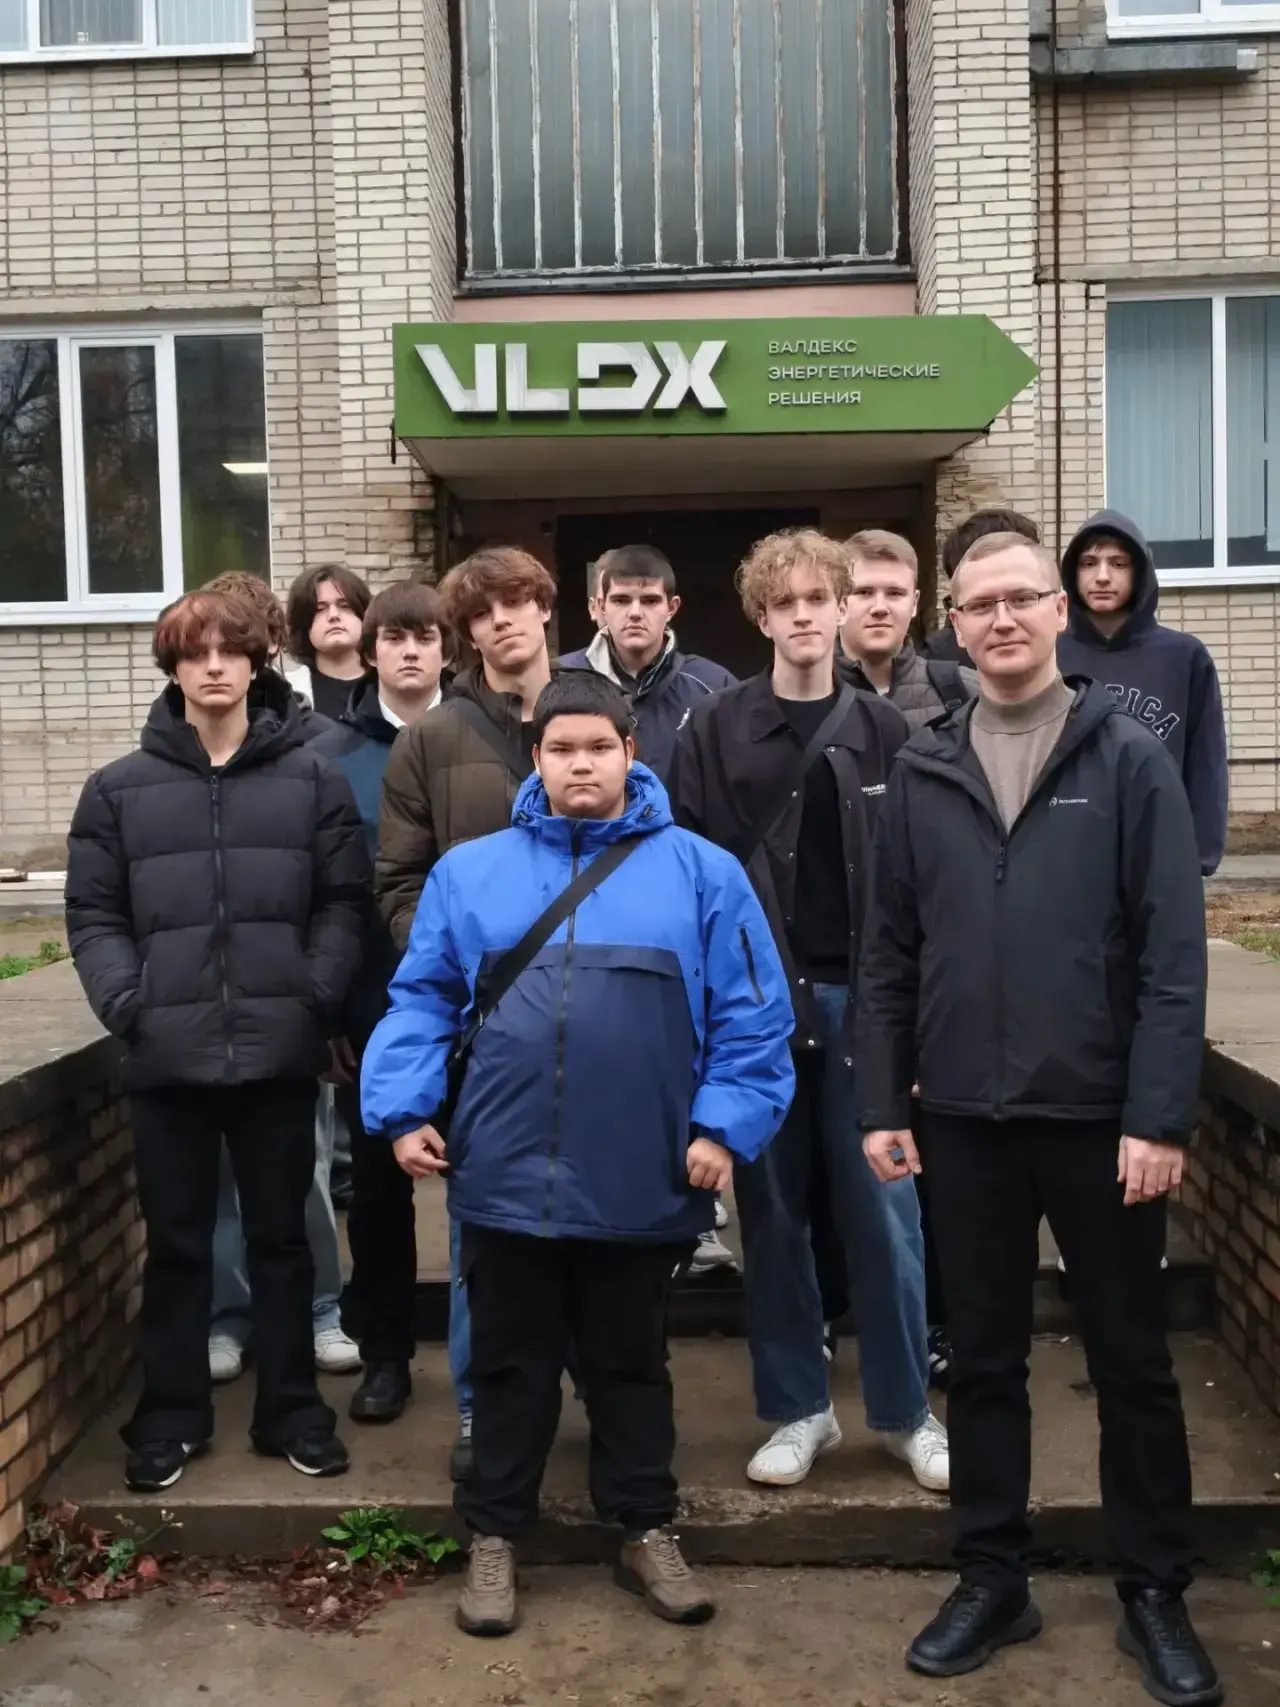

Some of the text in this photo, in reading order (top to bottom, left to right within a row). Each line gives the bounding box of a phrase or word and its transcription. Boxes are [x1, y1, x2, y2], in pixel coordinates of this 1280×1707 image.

[768, 340, 858, 355] ВАЛДЕКС
[414, 340, 728, 412] VLDX
[767, 363, 941, 380] ЭНЕРГЕТИЧЕСКИЕ
[768, 391, 862, 405] РЕШЕНИЯ
